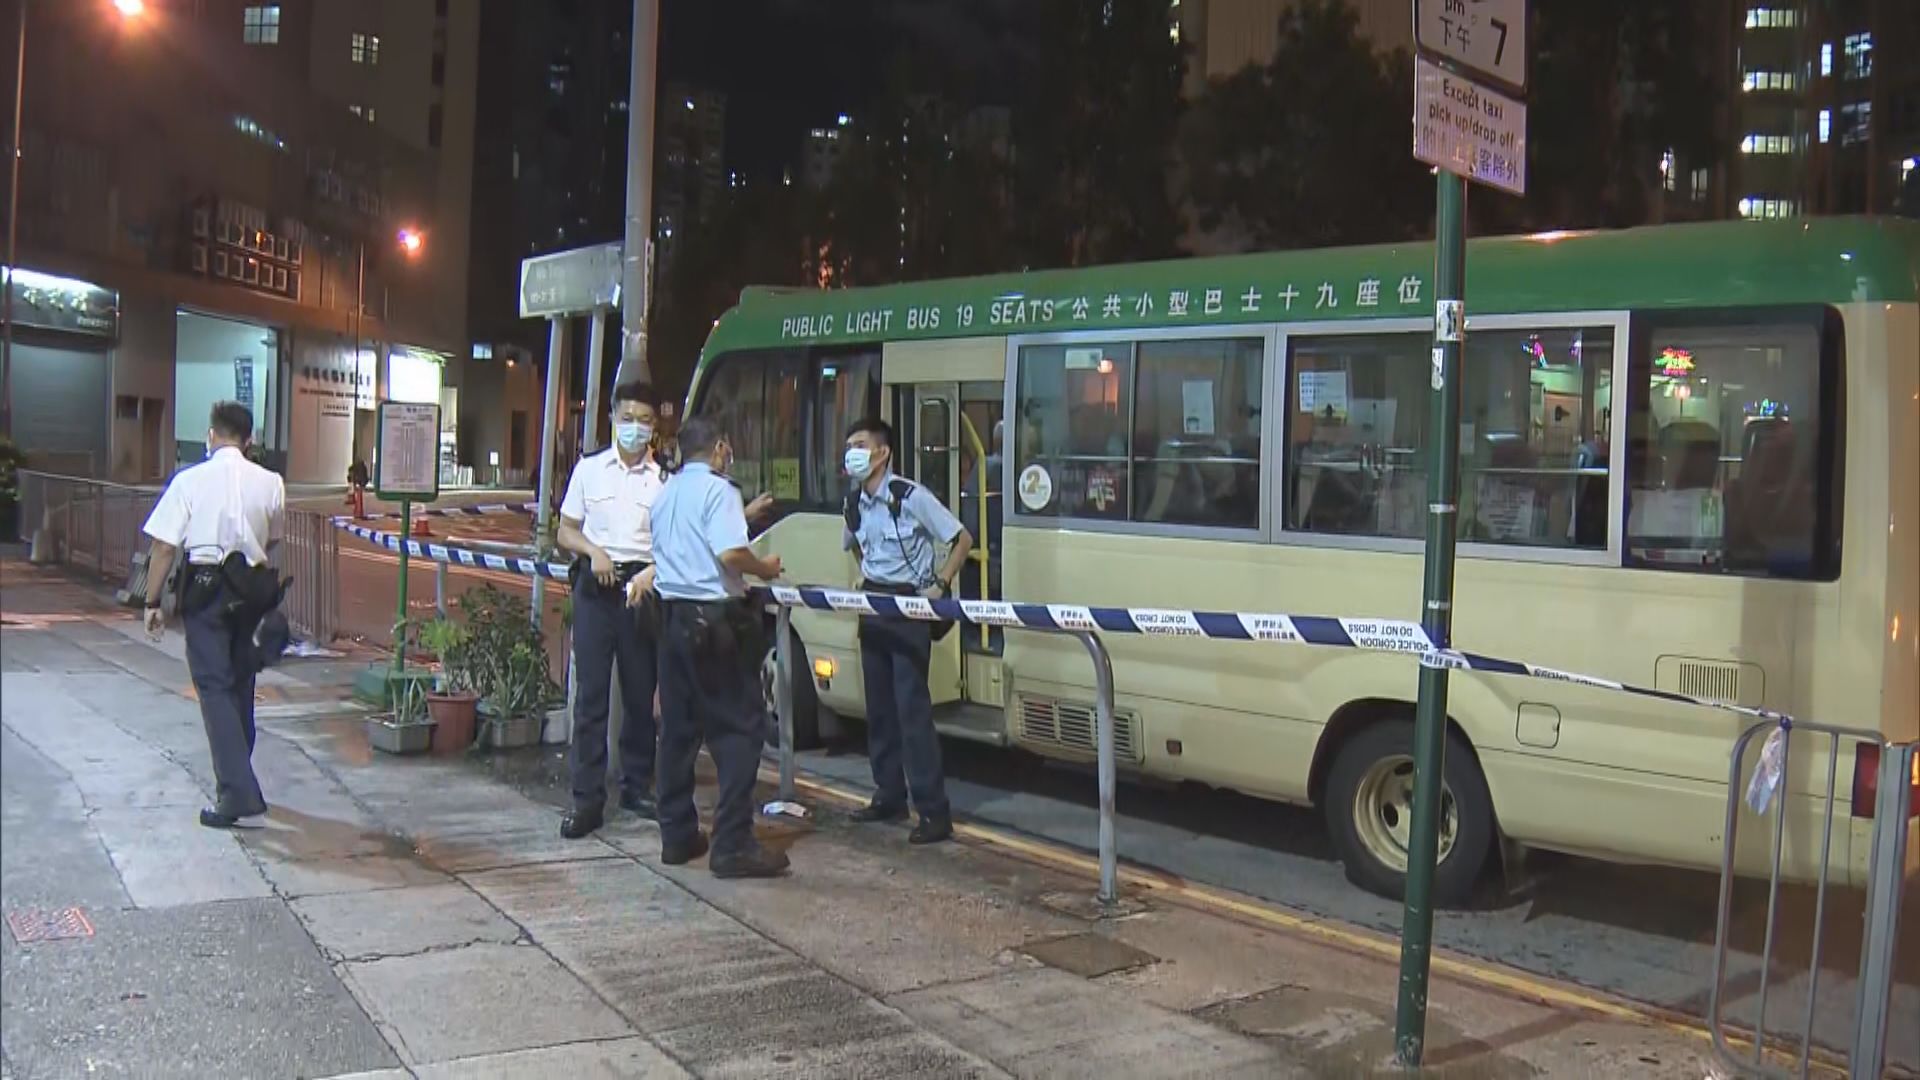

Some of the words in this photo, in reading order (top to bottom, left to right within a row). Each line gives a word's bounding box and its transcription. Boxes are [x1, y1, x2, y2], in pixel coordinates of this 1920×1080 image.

[1439, 15, 1471, 53] 下午
[1490, 17, 1507, 66] 7
[1442, 78, 1480, 111] Except
[1483, 96, 1503, 120] taxi
[1429, 102, 1451, 124] pick
[1455, 110, 1496, 143] up/drop
[1499, 131, 1514, 150] off
[1072, 276, 1422, 320] 公共小型巴士十九座位
[782, 314, 834, 338] PUBLIC
[846, 310, 893, 333] LIGHT
[907, 307, 940, 329] BUS
[957, 305, 973, 326] 19
[990, 300, 1054, 324] SEATS
[1348, 623, 1377, 634] CROSS
[1381, 625, 1399, 635] NOT
[1397, 639, 1429, 651] POLICE
[1399, 626, 1413, 637] DO
